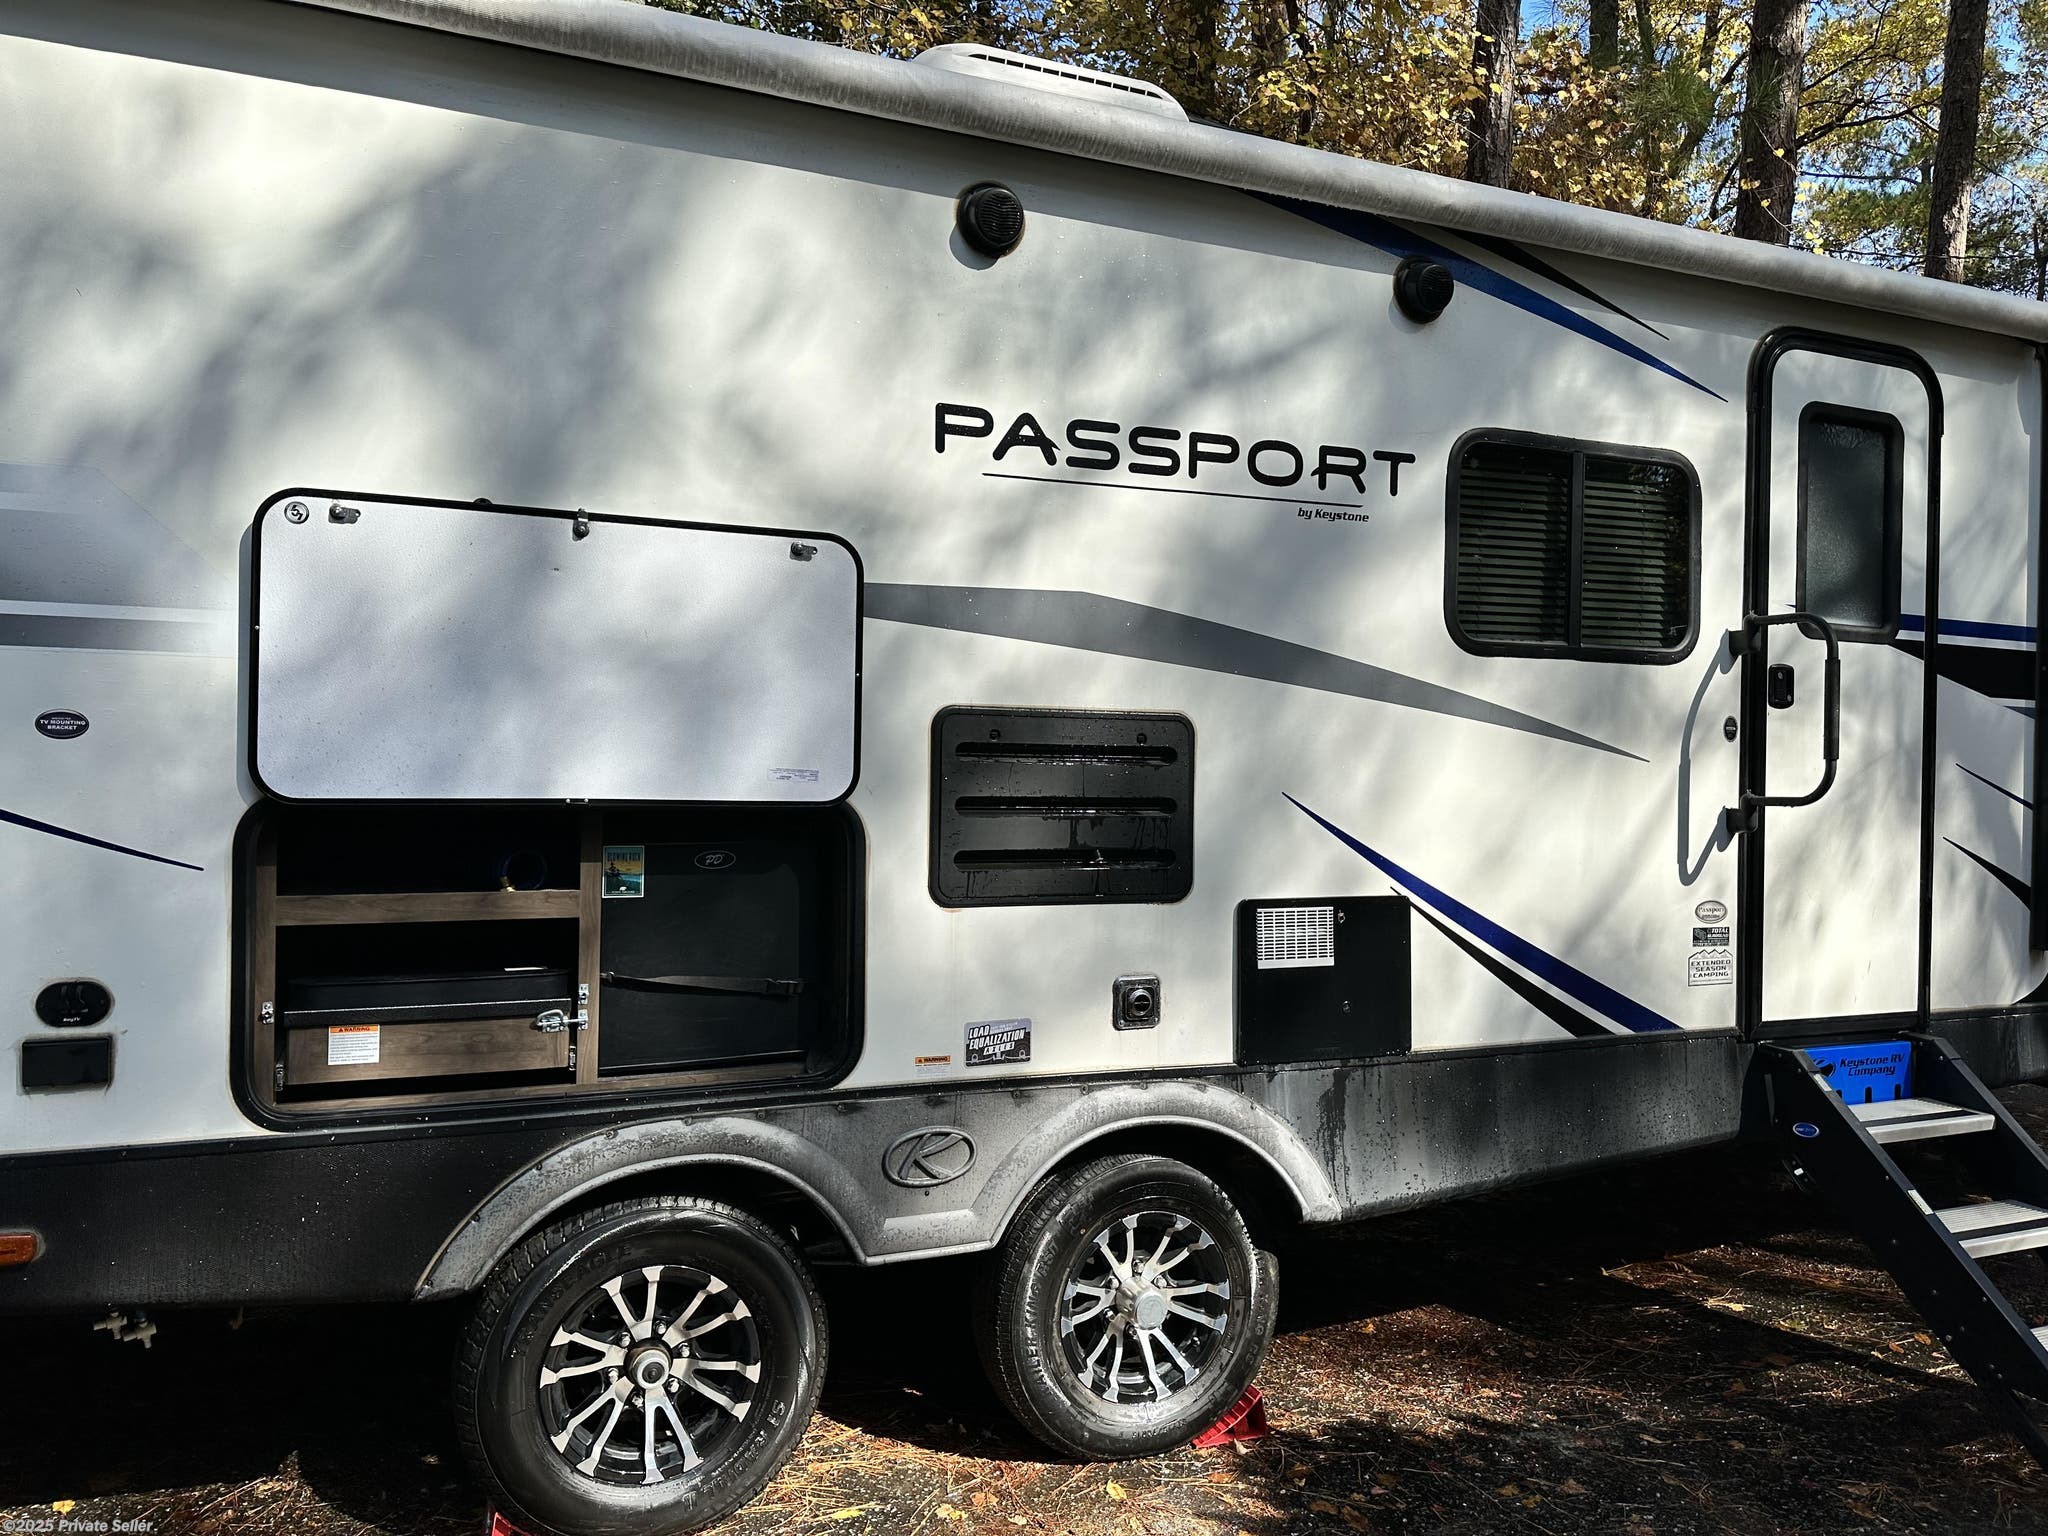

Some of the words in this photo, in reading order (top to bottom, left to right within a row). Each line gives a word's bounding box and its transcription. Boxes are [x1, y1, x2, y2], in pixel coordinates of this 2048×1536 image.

[935, 402, 1417, 497] PASSPORT
[1297, 507, 1313, 520] by
[1314, 508, 1370, 522] Keystone
[1691, 959, 1731, 967] EXTENDED
[1692, 970, 1729, 978] CAMPING
[968, 1025, 991, 1039] LOAD
[968, 1029, 1026, 1050] EQUALIZATION
[1840, 1055, 1889, 1069] Keystone
[1891, 1053, 1905, 1063] RV
[1848, 1064, 1896, 1077] Company
